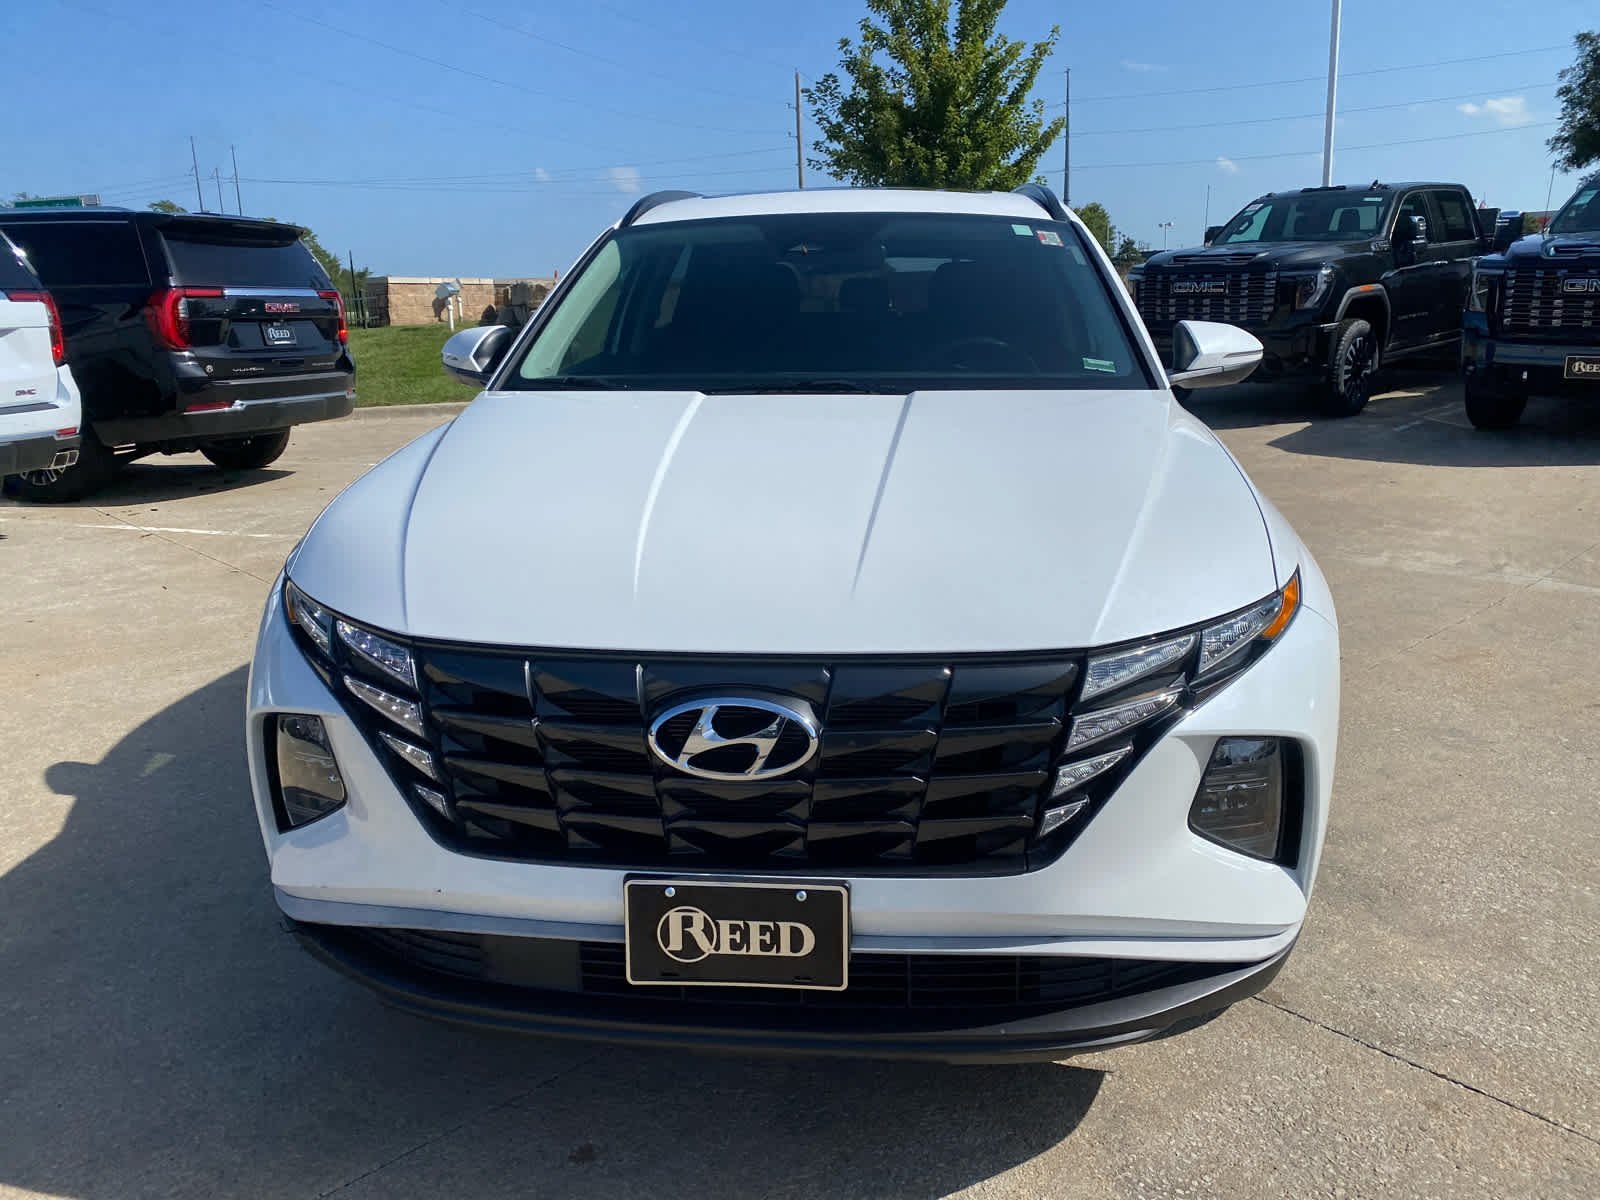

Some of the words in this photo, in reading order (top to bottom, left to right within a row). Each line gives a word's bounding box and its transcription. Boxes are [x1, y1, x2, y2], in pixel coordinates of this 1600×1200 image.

[1173, 281, 1225, 293] GMC
[264, 303, 300, 313] GMC
[268, 327, 290, 339] REED
[665, 911, 816, 957] REED
